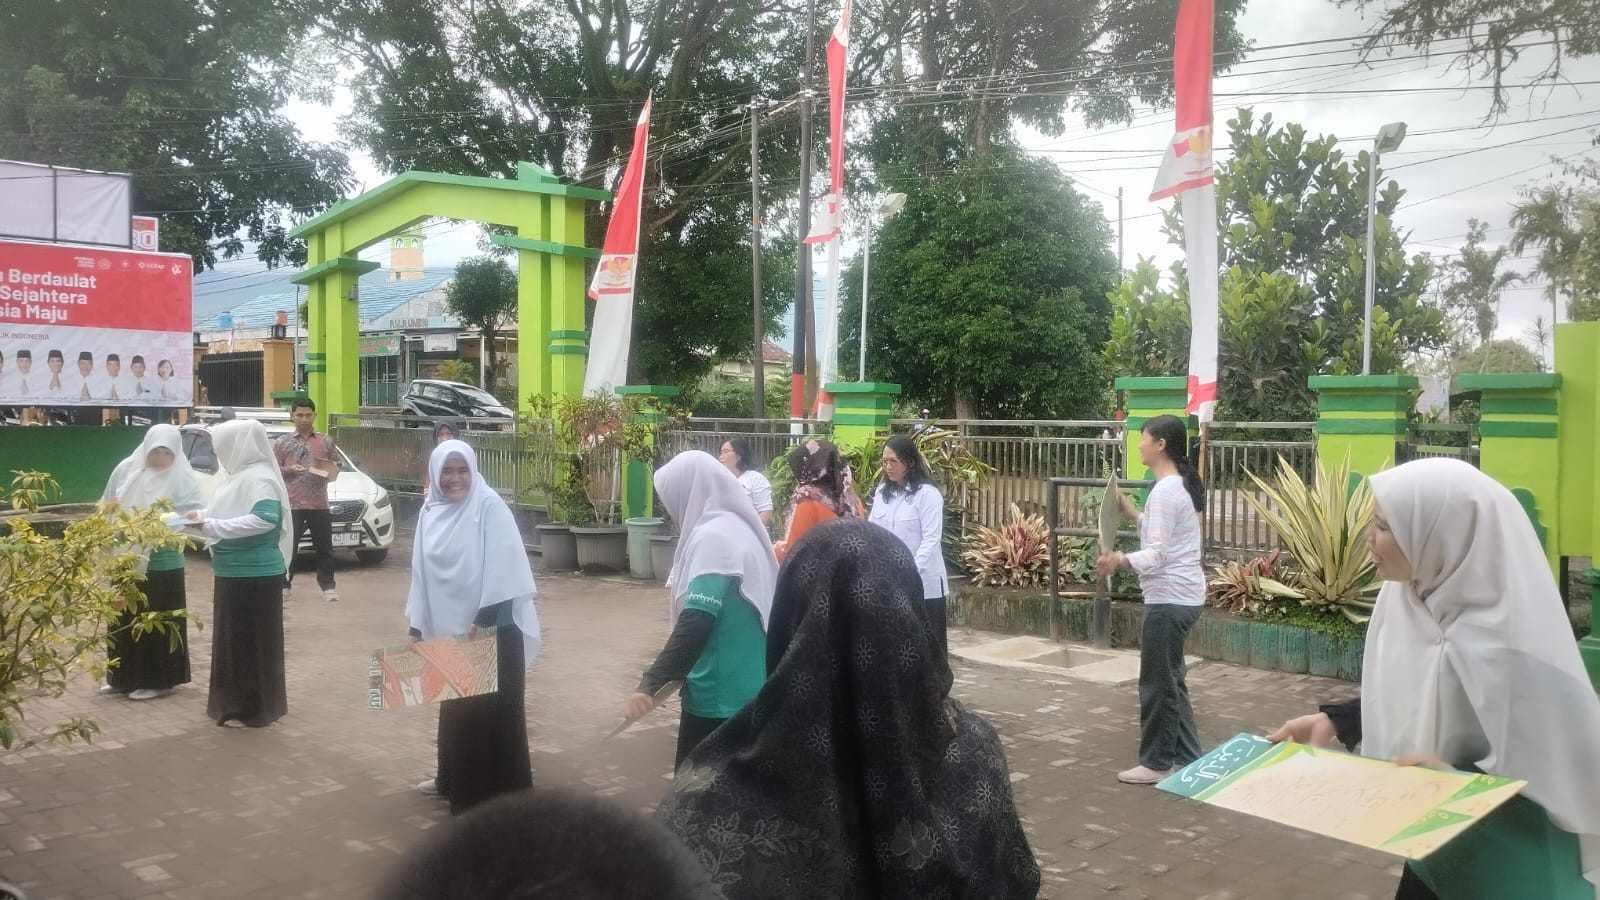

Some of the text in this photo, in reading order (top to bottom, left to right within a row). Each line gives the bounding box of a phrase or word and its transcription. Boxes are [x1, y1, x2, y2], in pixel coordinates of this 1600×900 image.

[8, 268, 97, 289] Berdaulat
[0, 286, 88, 304] Sejahtera
[26, 304, 68, 323] Maju
